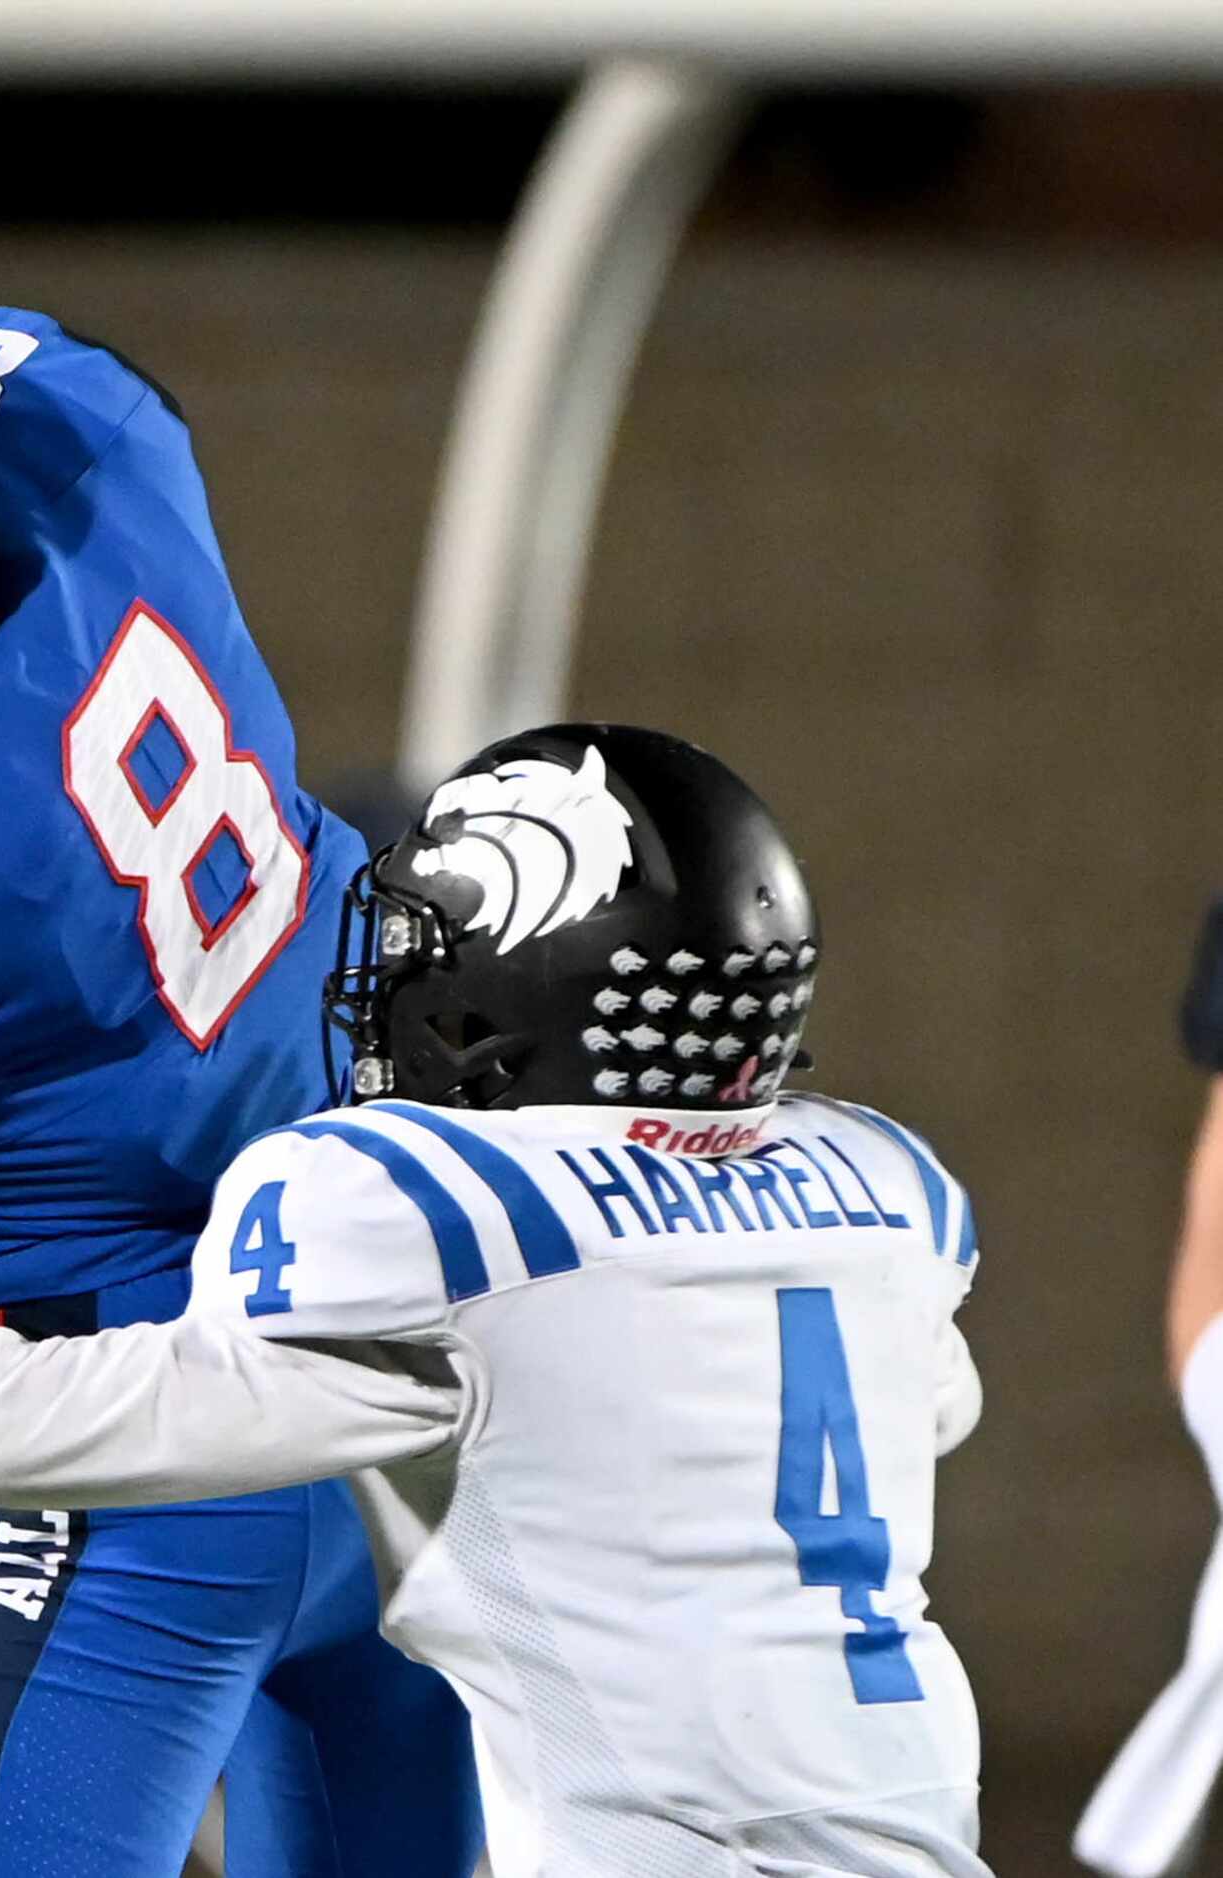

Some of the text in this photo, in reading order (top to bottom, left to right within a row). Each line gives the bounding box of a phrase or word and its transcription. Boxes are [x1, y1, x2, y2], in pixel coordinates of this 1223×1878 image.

[61, 596, 311, 1052] 8
[229, 1180, 296, 1318] 4
[556, 1136, 911, 1238] HARRELL
[774, 1286, 925, 1705] 4
